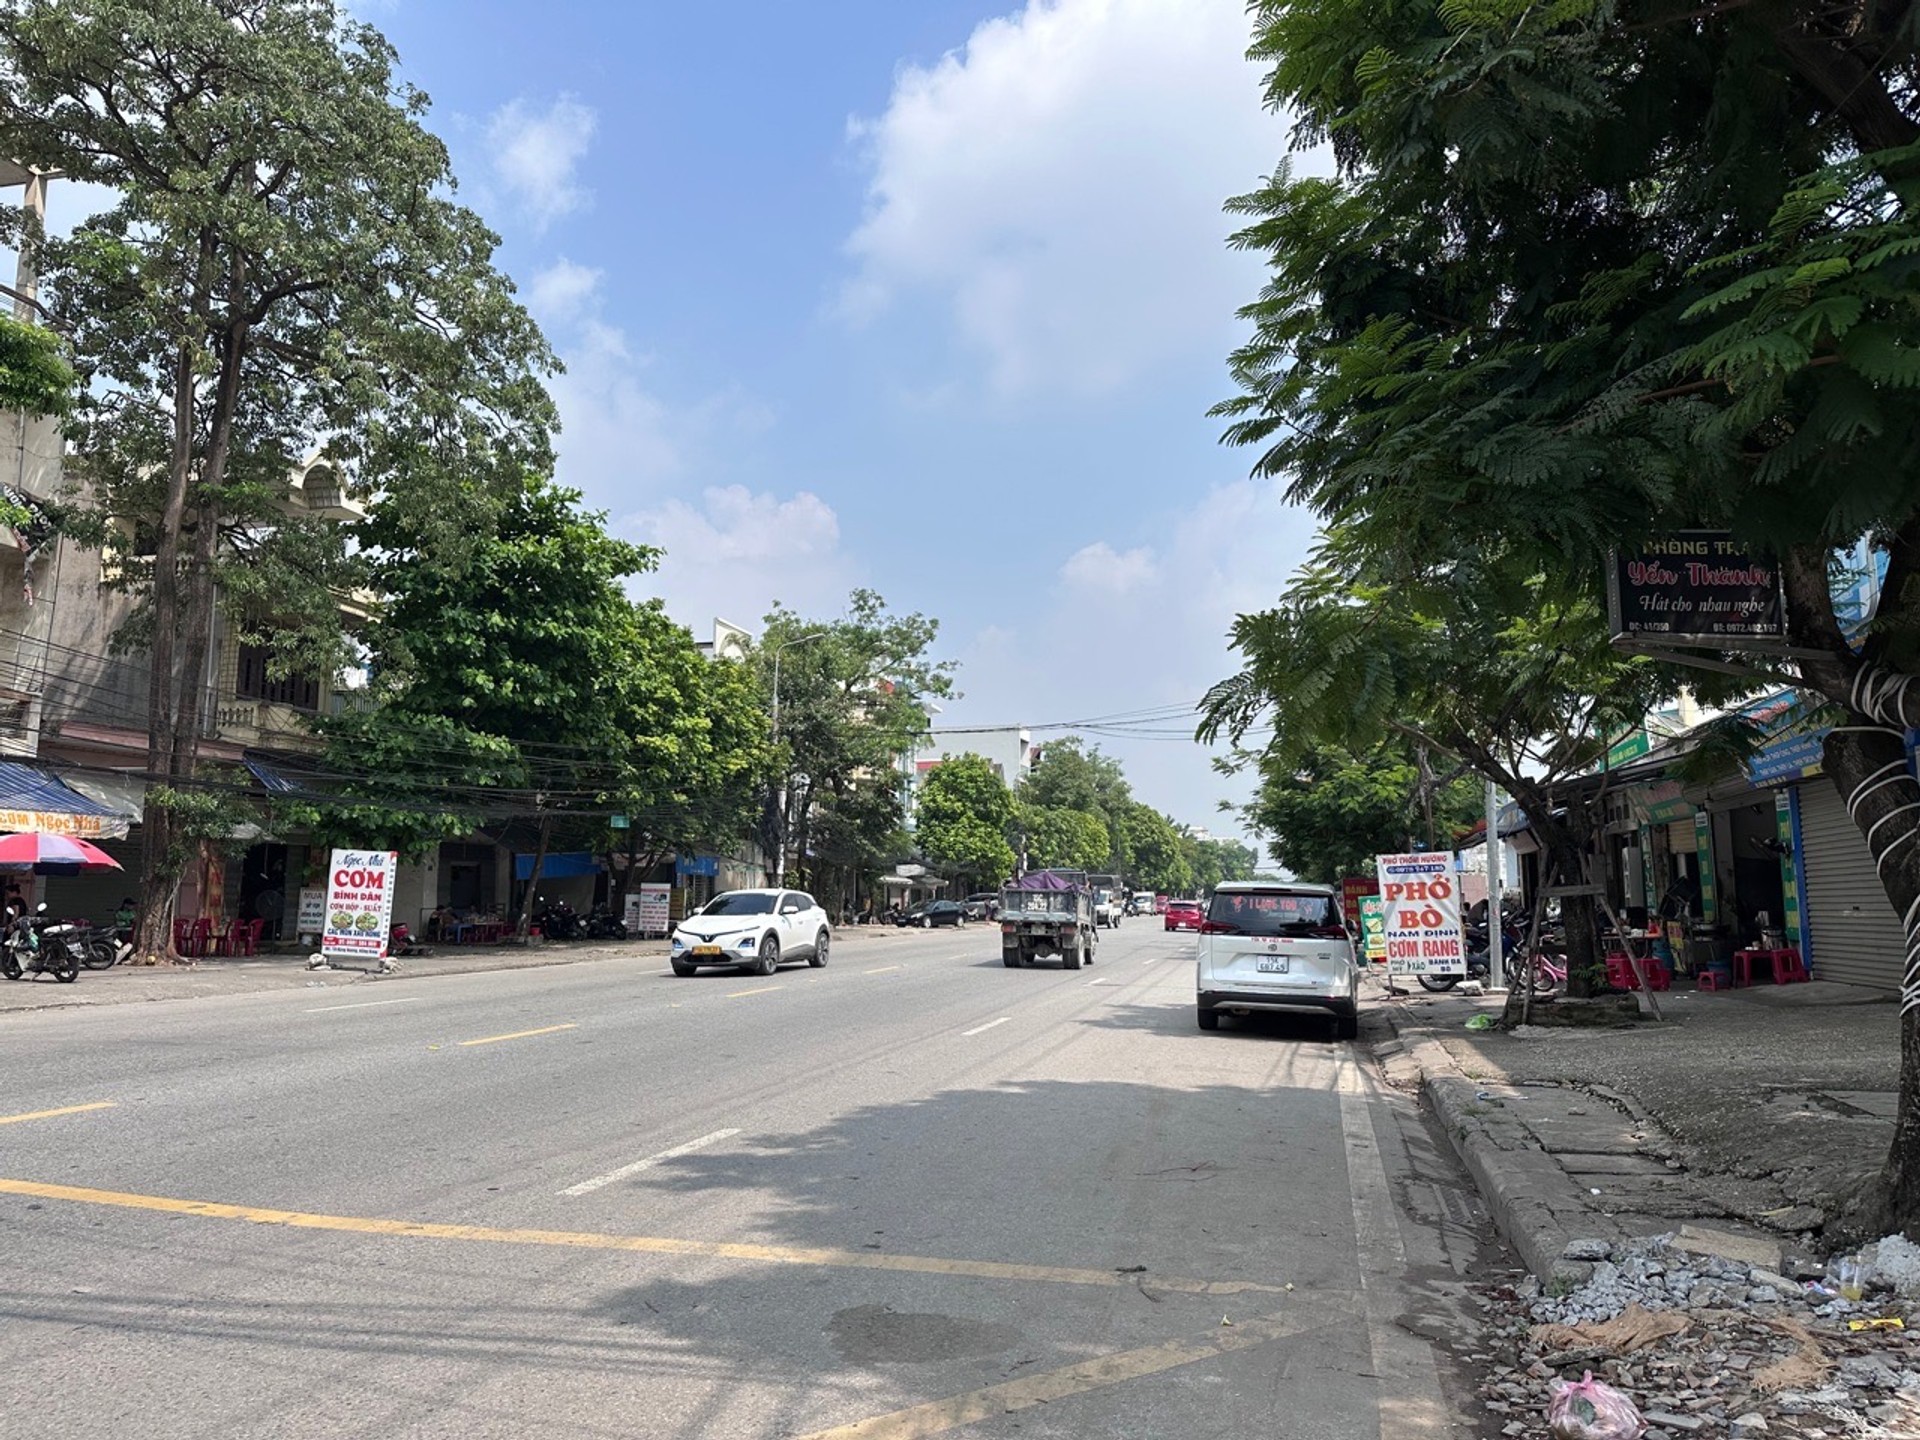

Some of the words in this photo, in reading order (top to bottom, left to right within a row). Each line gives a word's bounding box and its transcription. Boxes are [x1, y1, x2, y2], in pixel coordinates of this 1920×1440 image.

[1714, 541, 1749, 556] TR
[1628, 560, 1678, 587] Yến
[1639, 592, 1669, 612] Hát
[1671, 596, 1692, 612] cho
[1698, 596, 1731, 612] nhau
[1734, 596, 1765, 617] nghe
[35, 812, 70, 832] Ngọc
[334, 867, 385, 889] CƠM
[1383, 873, 1452, 902] PHỞ
[333, 890, 358, 900] BÌNH
[360, 891, 382, 901] DÂN
[1398, 903, 1443, 929] BÒ
[1424, 930, 1459, 938] ĐỊNH
[1388, 939, 1418, 958] CƠM
[1423, 940, 1459, 957] RANG
